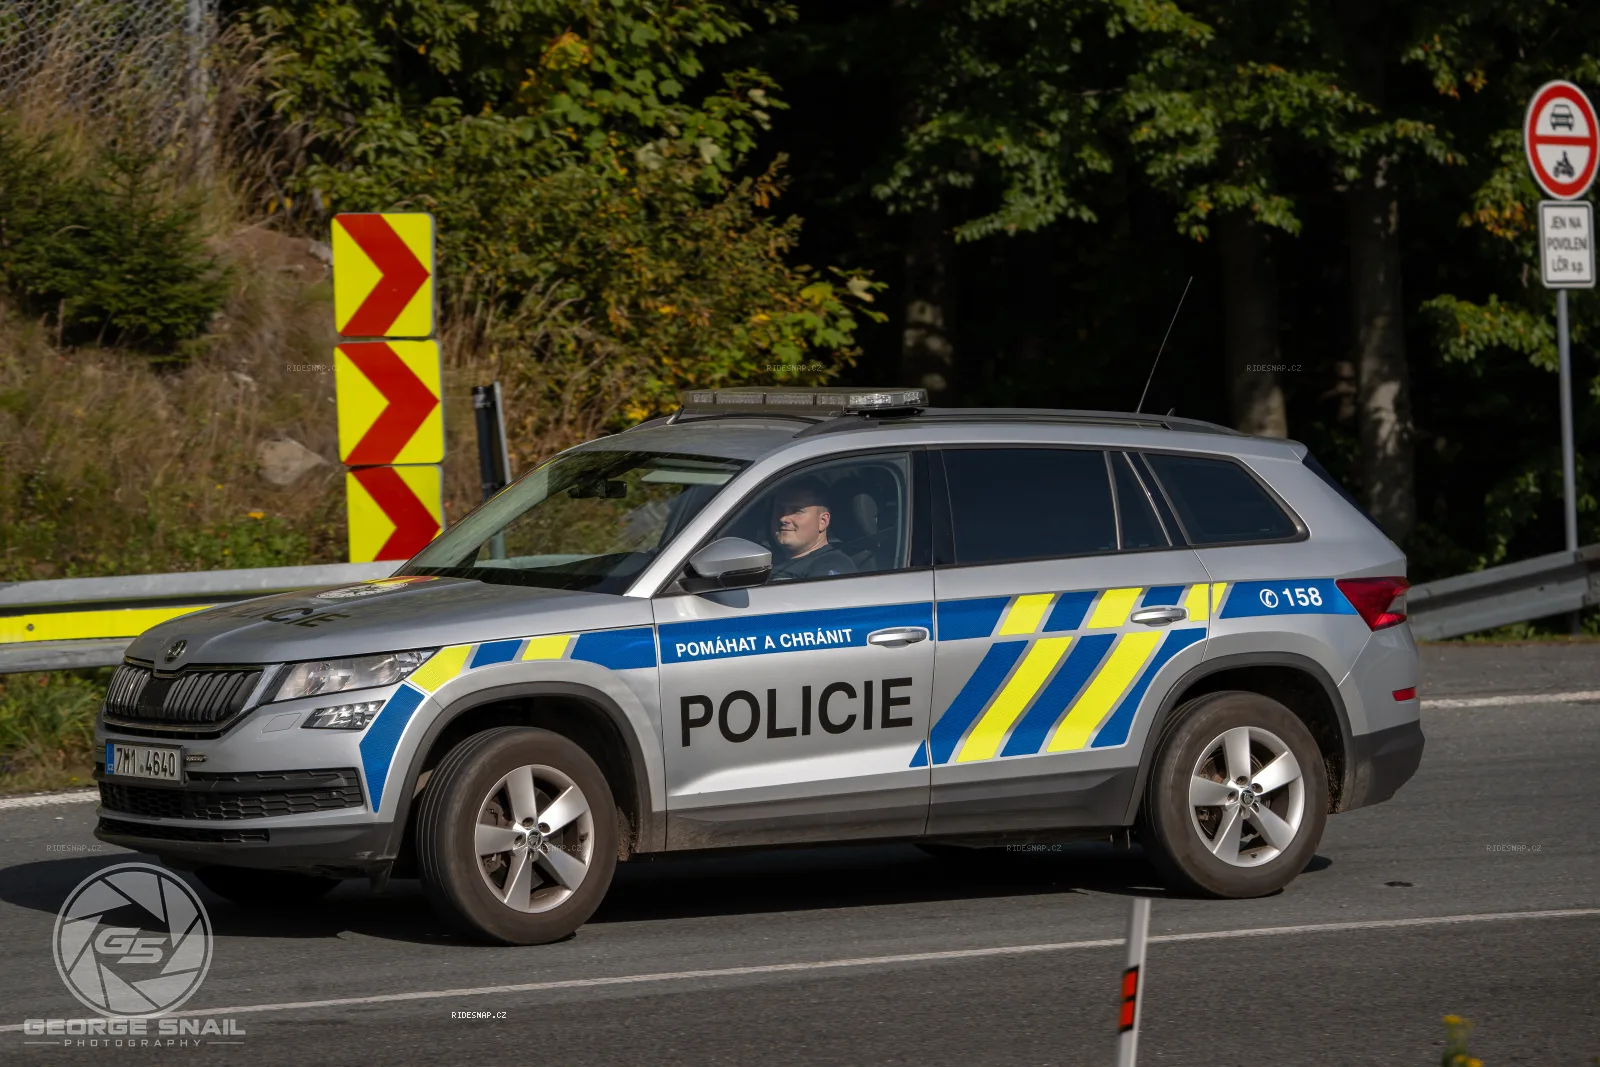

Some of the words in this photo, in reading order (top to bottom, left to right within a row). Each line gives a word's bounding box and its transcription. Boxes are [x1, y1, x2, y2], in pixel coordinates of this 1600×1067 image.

[1550, 215, 1567, 230] JEN
[1568, 216, 1582, 229] NA
[1282, 586, 1323, 607] 158
[675, 635, 757, 658] POMÁHAT
[764, 635, 776, 650] A
[780, 626, 852, 648] CHRÁNIT
[680, 676, 913, 747] POLICIE
[116, 746, 136, 774] 7M1
[145, 749, 176, 777] 4640
